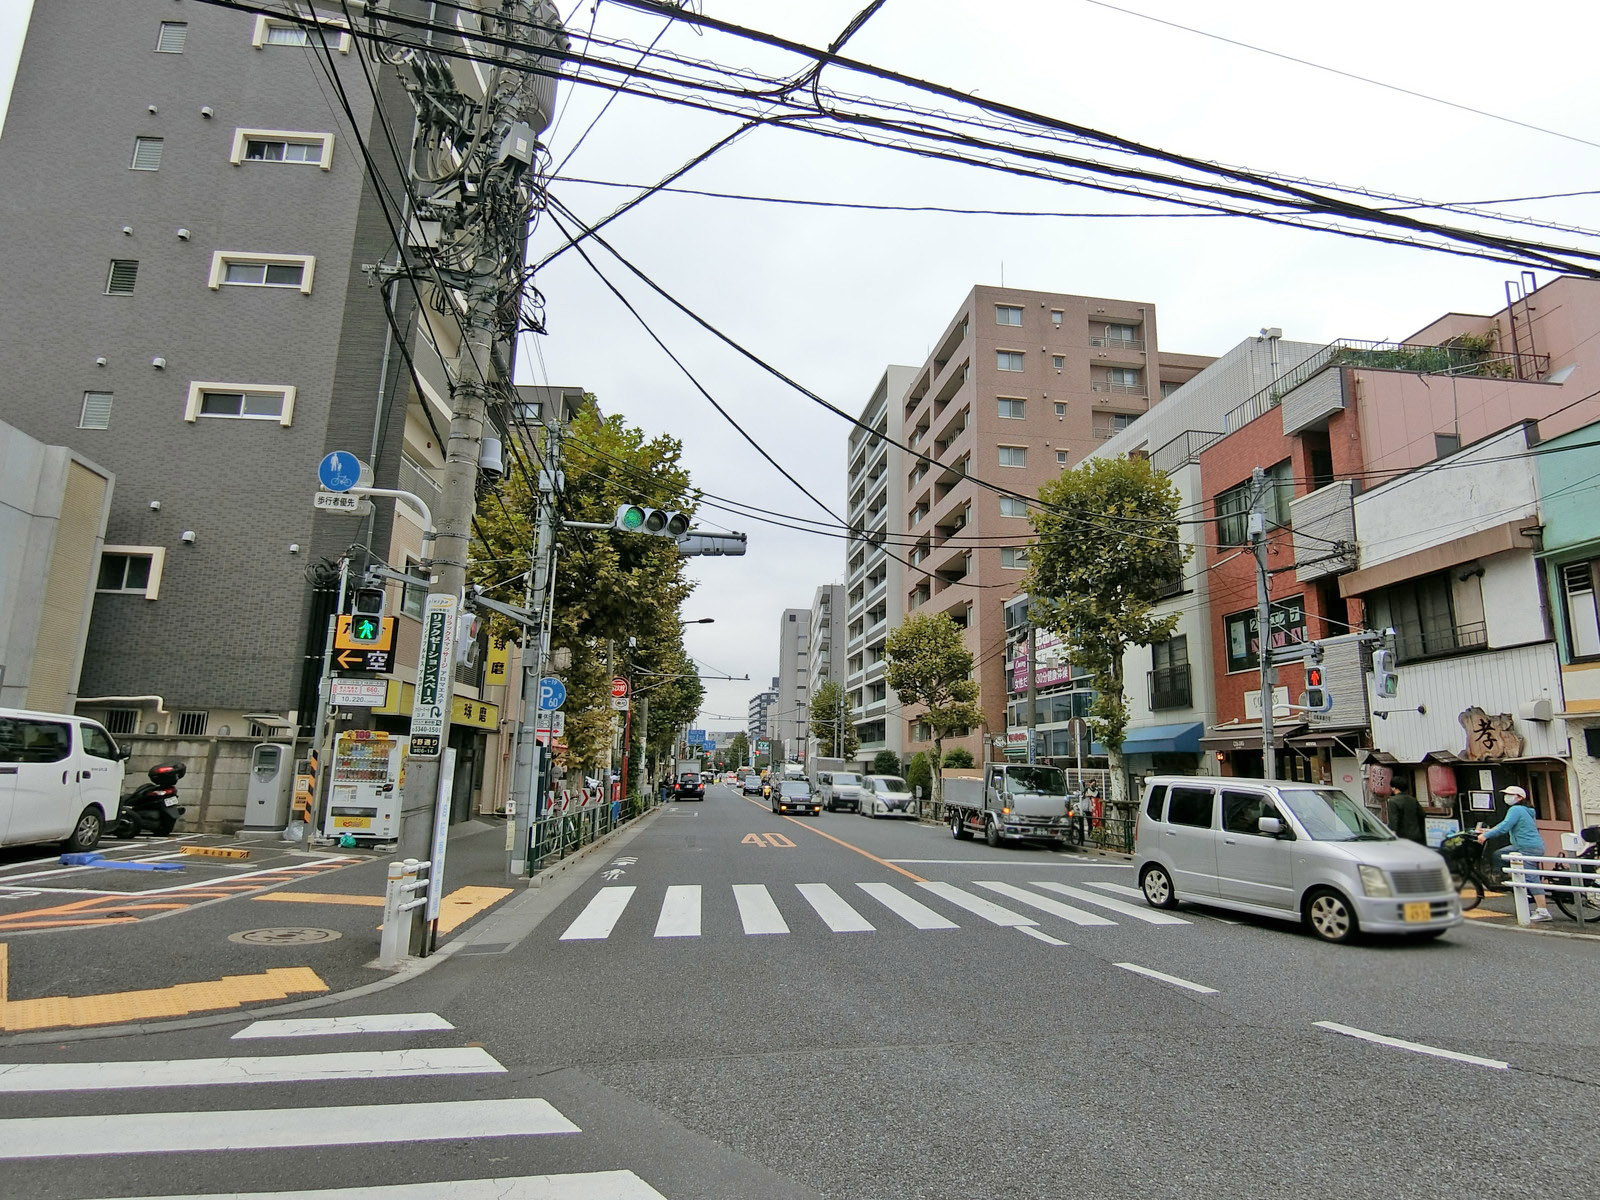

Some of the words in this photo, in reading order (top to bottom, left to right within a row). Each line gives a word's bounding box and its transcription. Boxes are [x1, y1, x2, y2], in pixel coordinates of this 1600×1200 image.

[317, 495, 356, 507] 歩行者優先
[1252, 628, 1302, 653] NVA
[366, 651, 388, 671] 空
[422, 614, 442, 704] リラクゼーションスペース
[540, 686, 553, 707] P
[412, 738, 438, 746] 中野通り
[1473, 718, 1498, 750] 孝
[741, 833, 797, 848] 40
